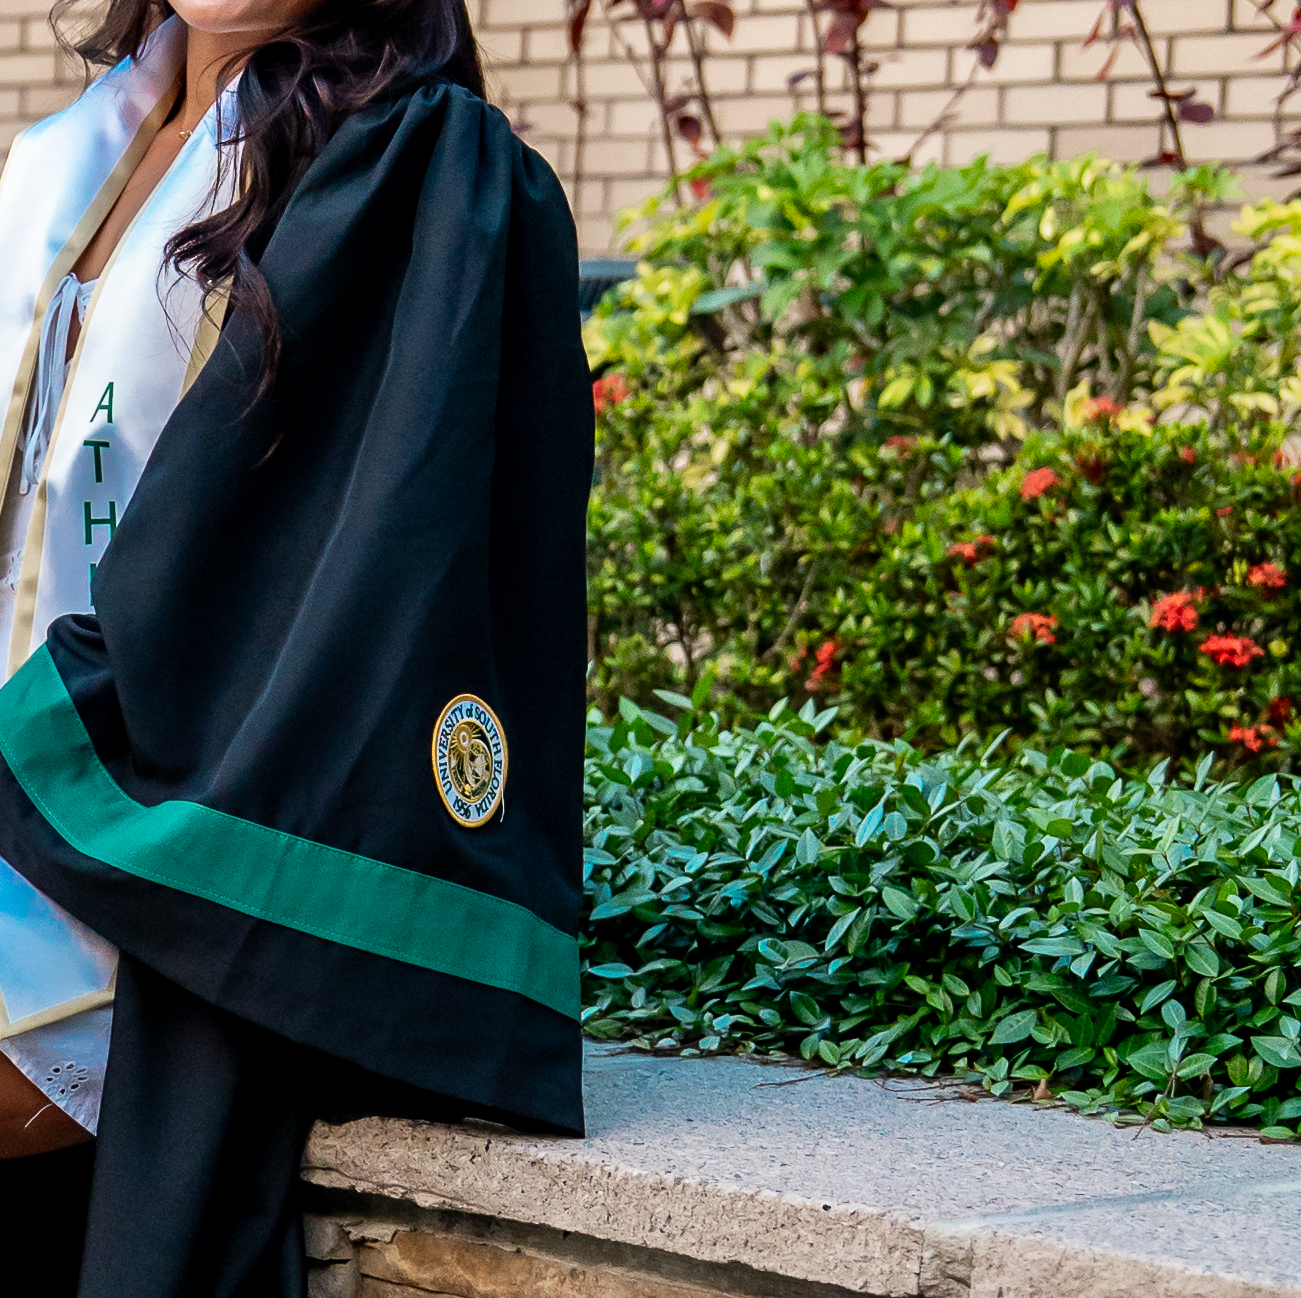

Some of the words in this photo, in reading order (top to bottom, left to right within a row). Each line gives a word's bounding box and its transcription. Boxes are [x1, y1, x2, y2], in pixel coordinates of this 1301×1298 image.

[465, 704, 474, 719] of
[474, 705, 502, 757] SOUTH
[439, 704, 464, 795] UNIVERSITY
[453, 796, 472, 819] 1956
[475, 759, 502, 817] FLORIDA
